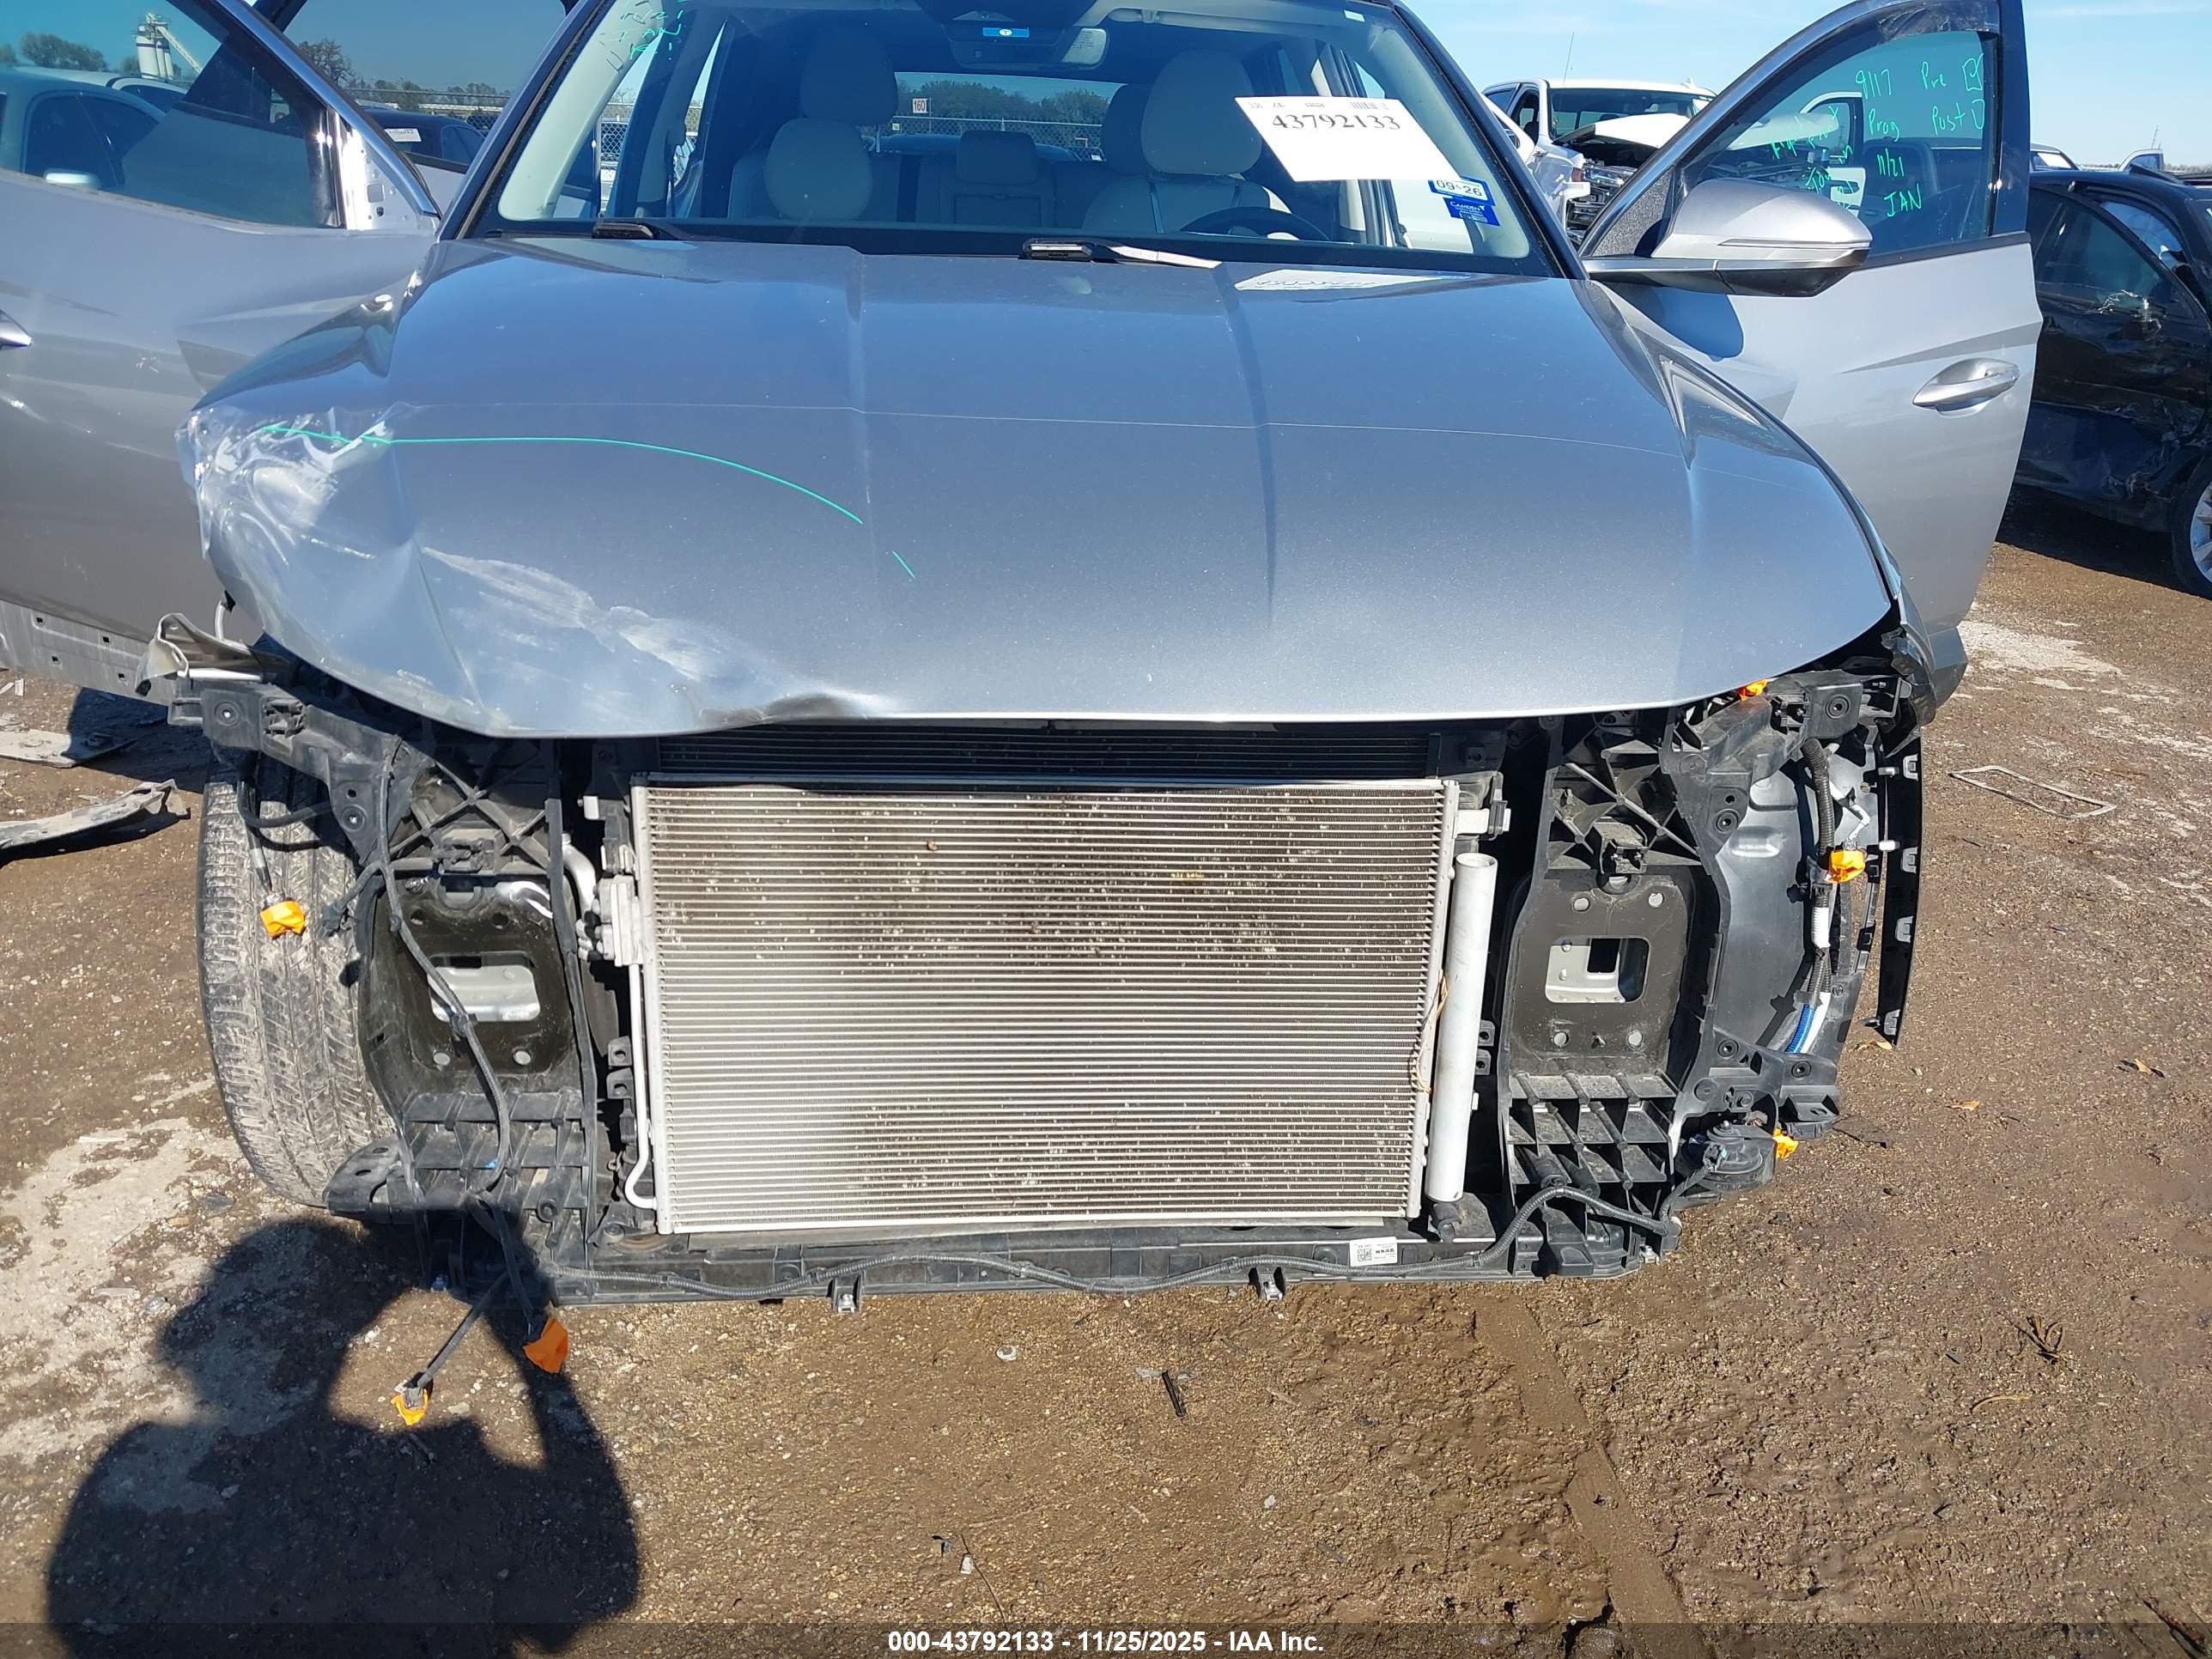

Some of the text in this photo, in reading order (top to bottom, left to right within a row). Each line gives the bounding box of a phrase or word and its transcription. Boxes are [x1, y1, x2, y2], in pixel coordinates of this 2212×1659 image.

[1272, 114, 1401, 130] 43792133
[1868, 108, 1900, 143] Prog
[1883, 182, 1923, 217] JAN
